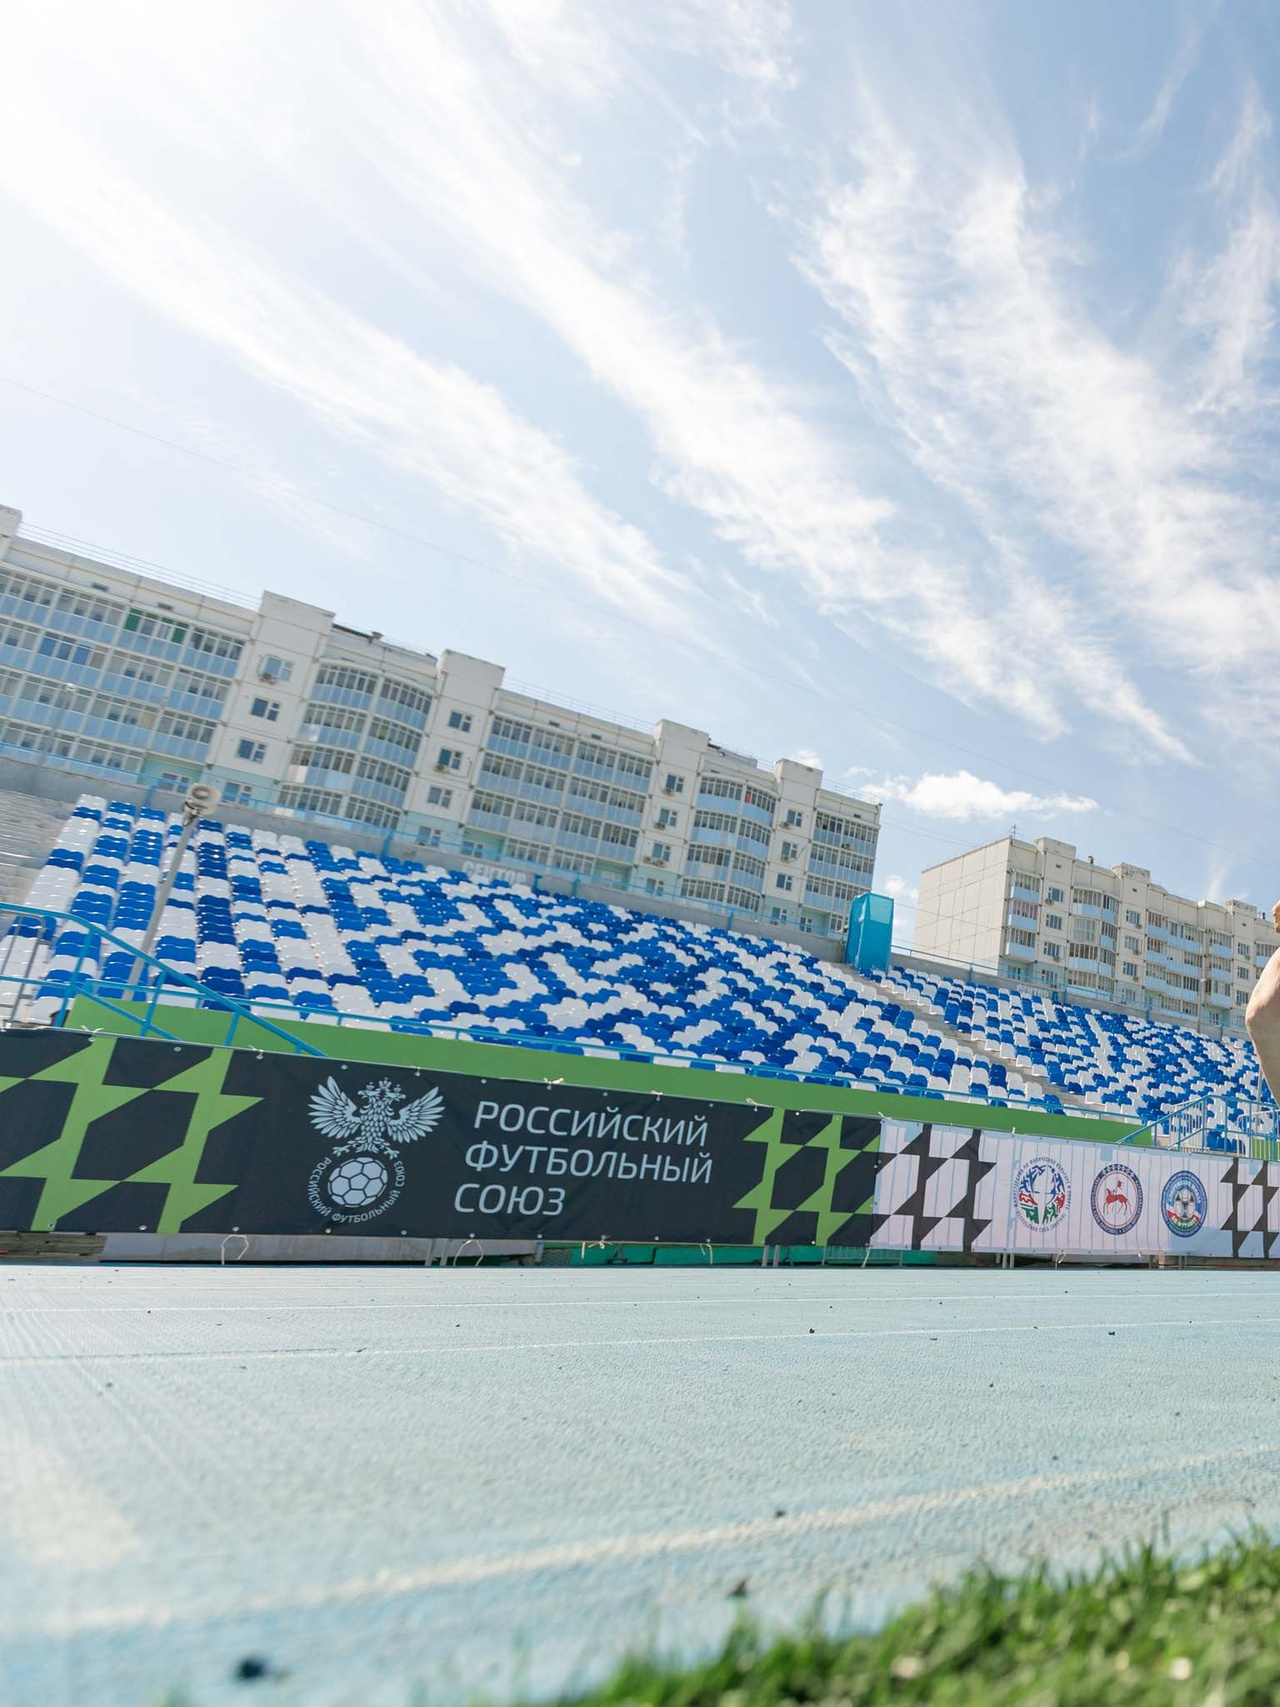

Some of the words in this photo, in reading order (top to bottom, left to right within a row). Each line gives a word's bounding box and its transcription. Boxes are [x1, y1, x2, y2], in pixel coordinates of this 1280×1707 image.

[473, 1100, 709, 1147] РОССИЙСКИЙ
[464, 1140, 714, 1184] ФУТБОЛЬНЫЙ
[307, 1156, 333, 1217] РОССИЙСКИЙ
[331, 1189, 401, 1223] ФУТБОЛЬНЫЙ
[393, 1160, 406, 1187] СОЮЗ
[454, 1183, 567, 1216] СОЮЗ
